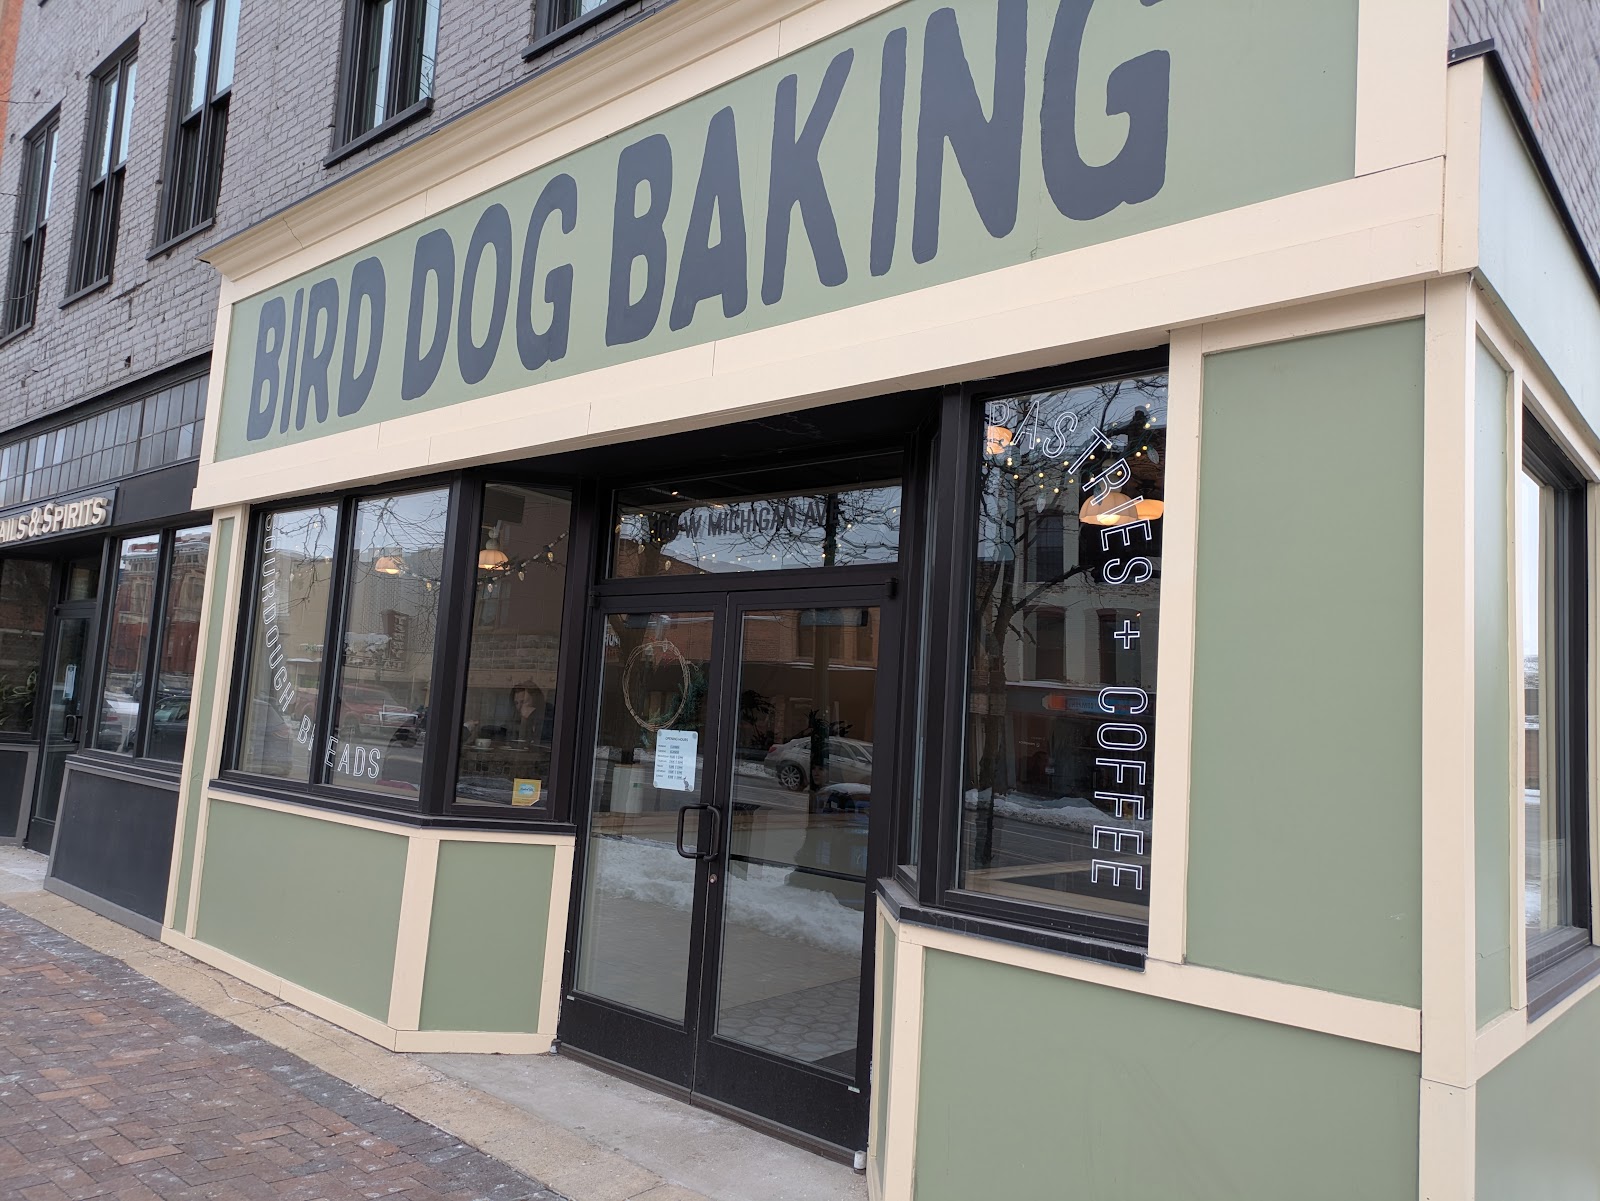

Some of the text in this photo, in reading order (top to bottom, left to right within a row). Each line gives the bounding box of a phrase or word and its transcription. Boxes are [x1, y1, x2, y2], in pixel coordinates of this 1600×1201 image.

[247, 0, 1171, 441] BIRD DOG BAKING
[261, 513, 296, 712] SOURDOUGH
[684, 514, 702, 538] W
[708, 503, 796, 537] MICHIGAN
[803, 499, 839, 526] AVE
[987, 400, 1152, 584] PASTRIES
[1091, 686, 1148, 890] COFFEE
